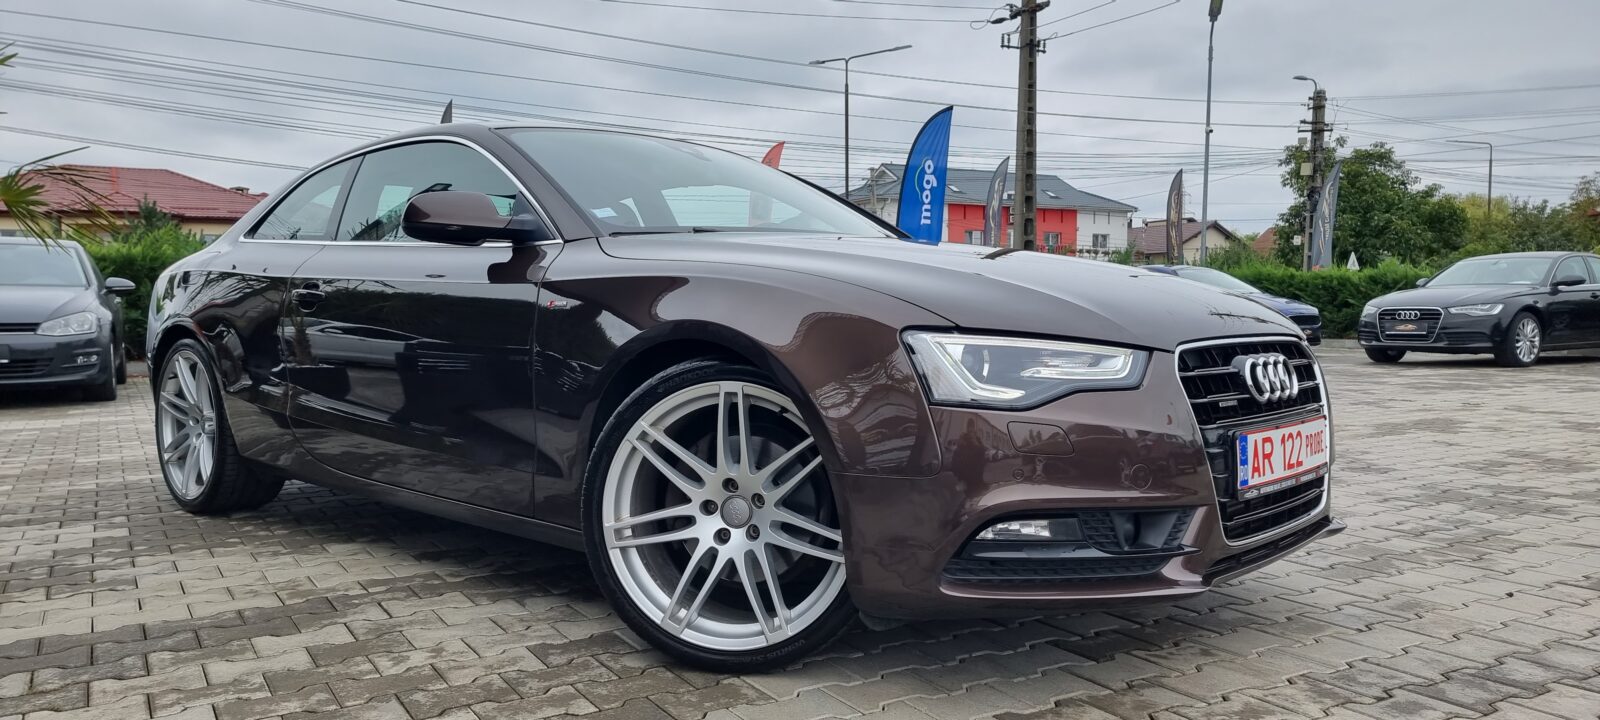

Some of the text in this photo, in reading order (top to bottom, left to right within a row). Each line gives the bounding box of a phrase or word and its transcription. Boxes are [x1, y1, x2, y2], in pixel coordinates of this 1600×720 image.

[920, 159, 938, 225] mogo
[1251, 429, 1324, 479] AR 122 PROBE
